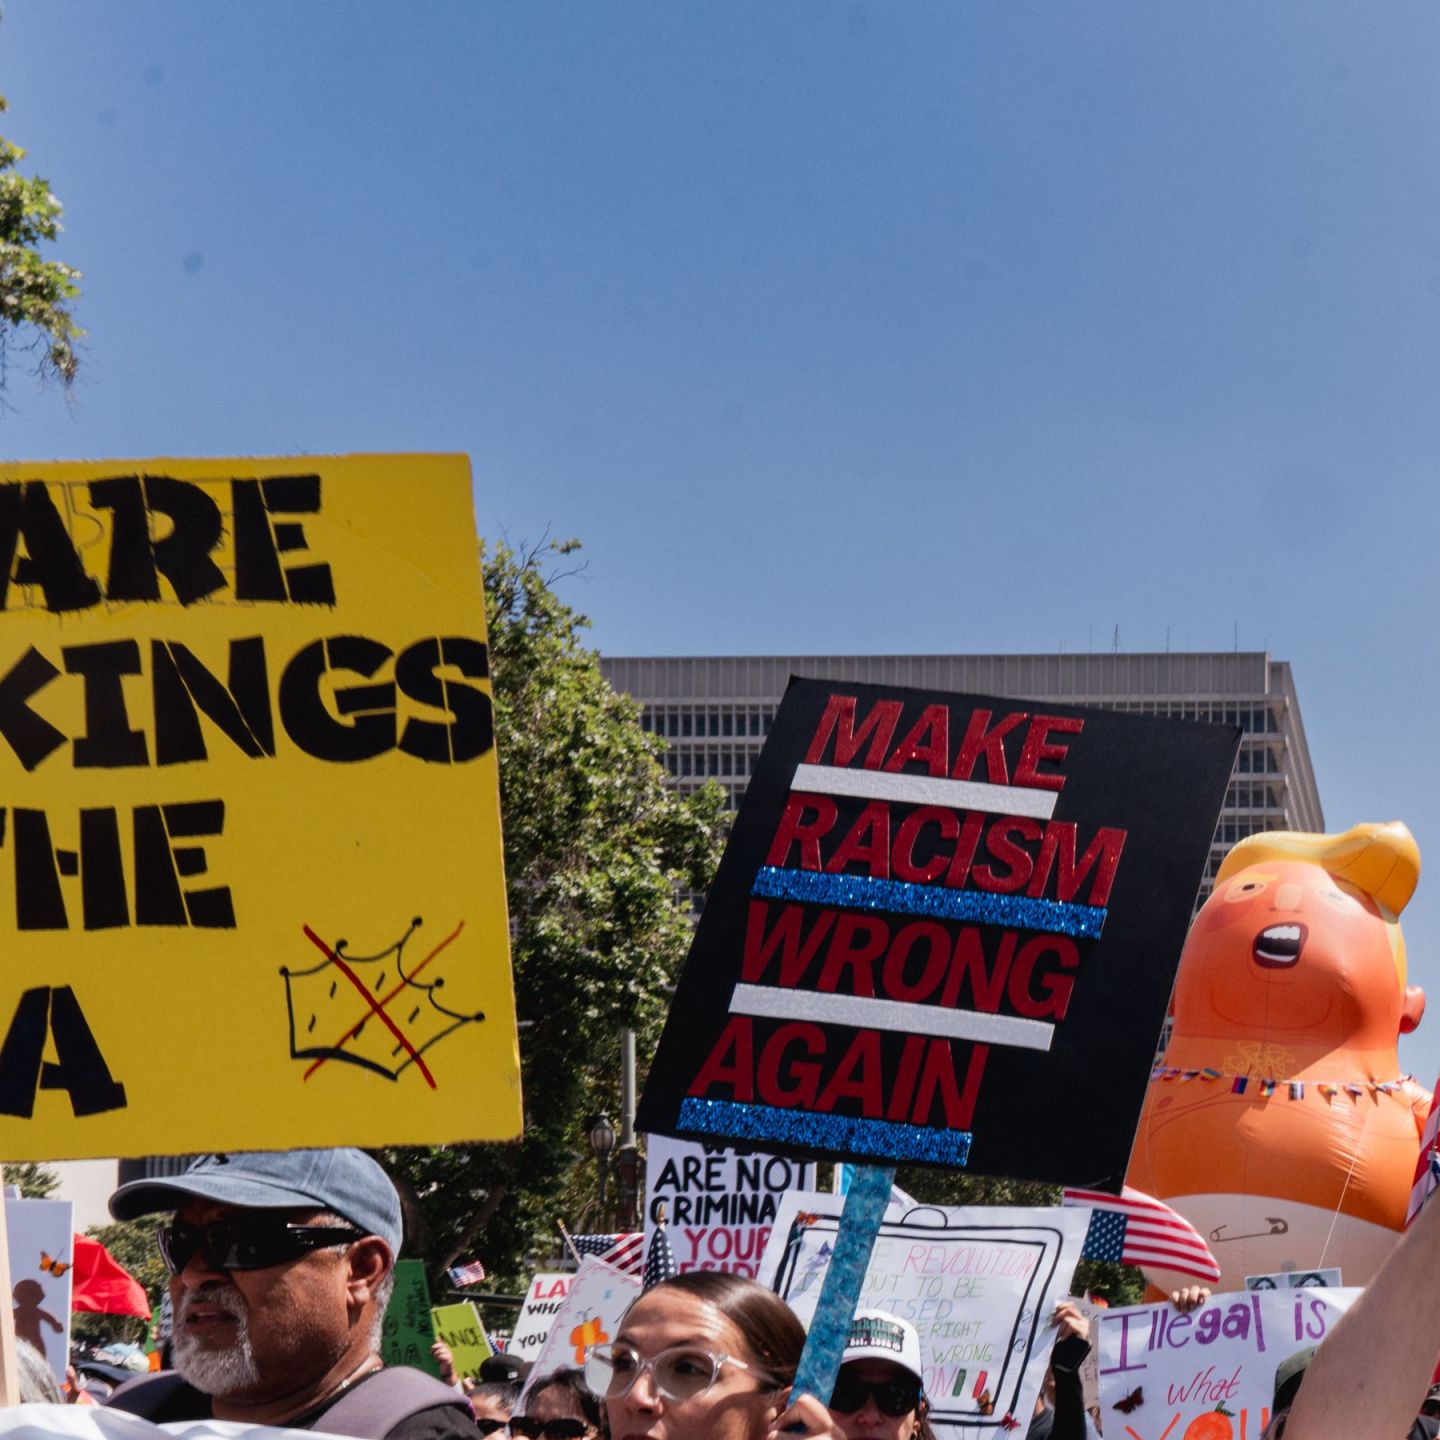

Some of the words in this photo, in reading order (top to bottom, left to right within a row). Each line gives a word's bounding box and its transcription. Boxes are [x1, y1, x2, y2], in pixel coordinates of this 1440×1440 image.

[0, 473, 336, 613] ARE
[804, 693, 1085, 790] MAKE
[0, 799, 236, 931] HE
[765, 790, 1128, 907] RACISM
[740, 900, 1080, 1021] WRONG
[687, 1016, 991, 1131] AGAIN
[650, 1193, 783, 1227] CRIMINA
[653, 1155, 727, 1193] ARE
[735, 1156, 818, 1193] NOT
[903, 1243, 1038, 1280] REVOLUTION
[916, 1275, 943, 1298] TO
[931, 1343, 994, 1364] WRONG
[1100, 1295, 1266, 1377] Illegal
[1294, 1293, 1327, 1342] is
[1167, 1365, 1244, 1406] What
